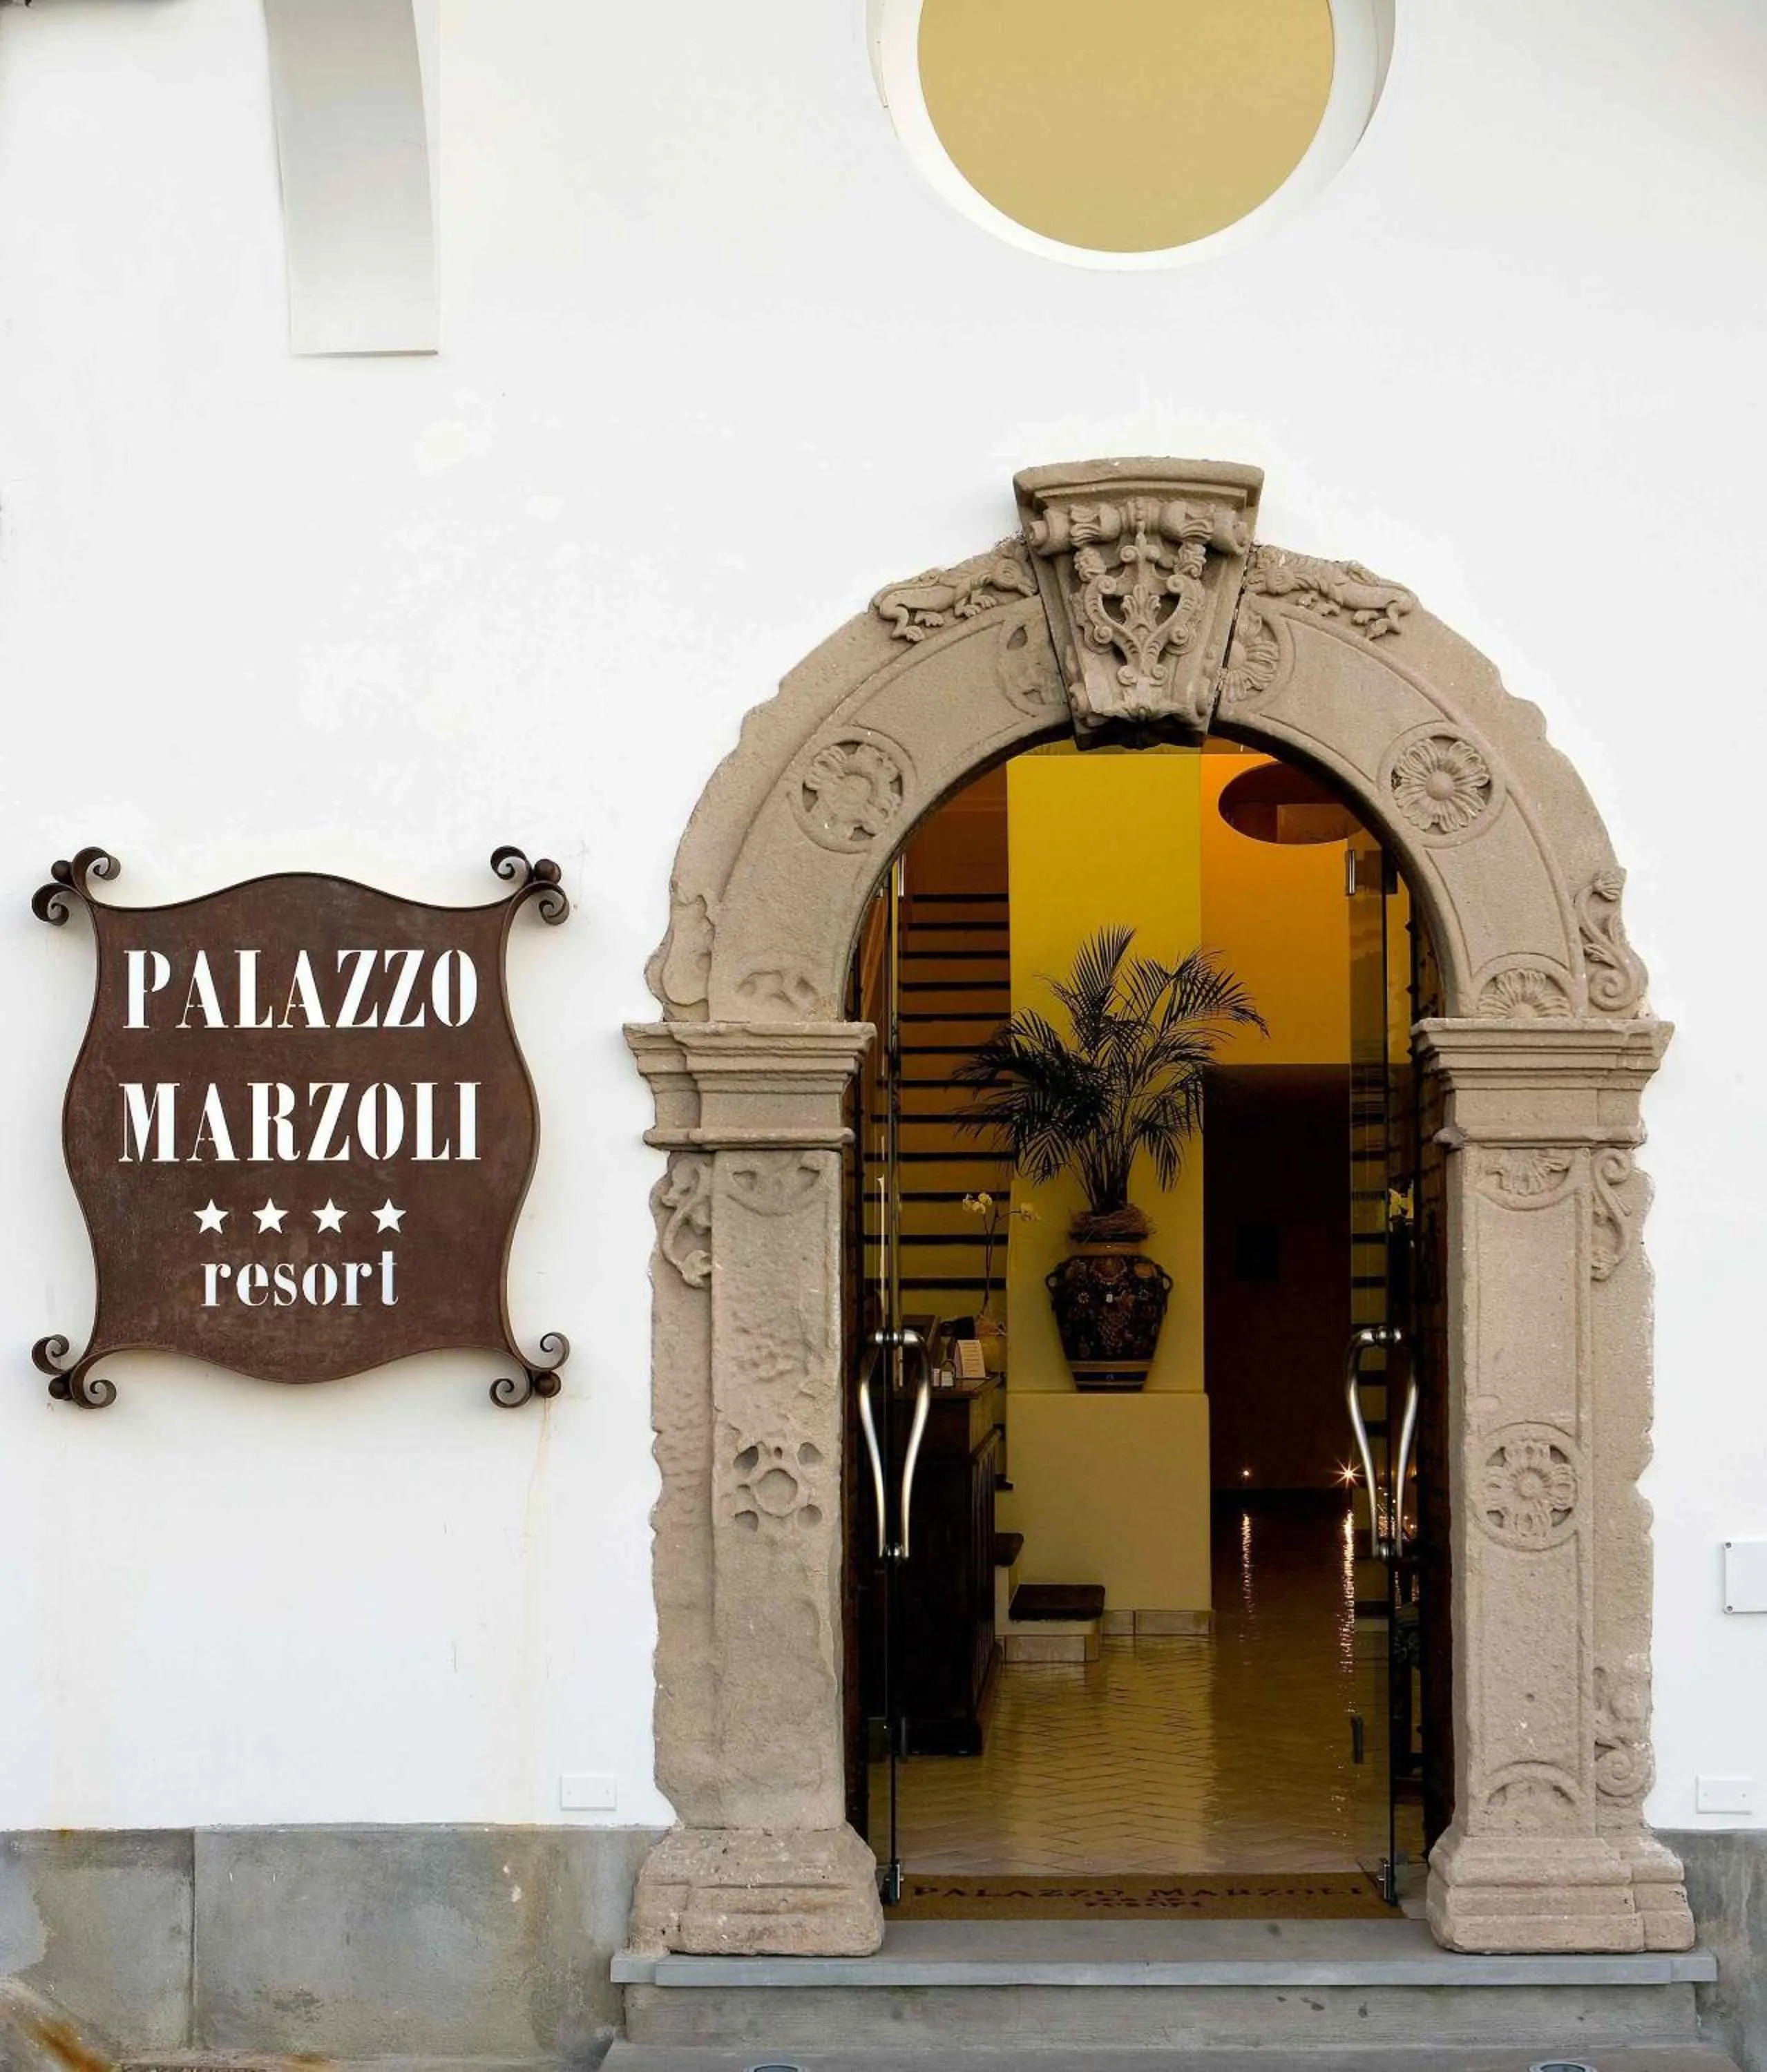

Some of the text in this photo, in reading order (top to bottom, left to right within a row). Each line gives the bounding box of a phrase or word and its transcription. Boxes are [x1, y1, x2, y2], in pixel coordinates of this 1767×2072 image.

[123, 949, 477, 1028] PALAZZO
[119, 1082, 481, 1162] MARZOLI
[200, 1250, 399, 1307] resort
[914, 1886, 1363, 1897] PALAZZO MARZOLI
